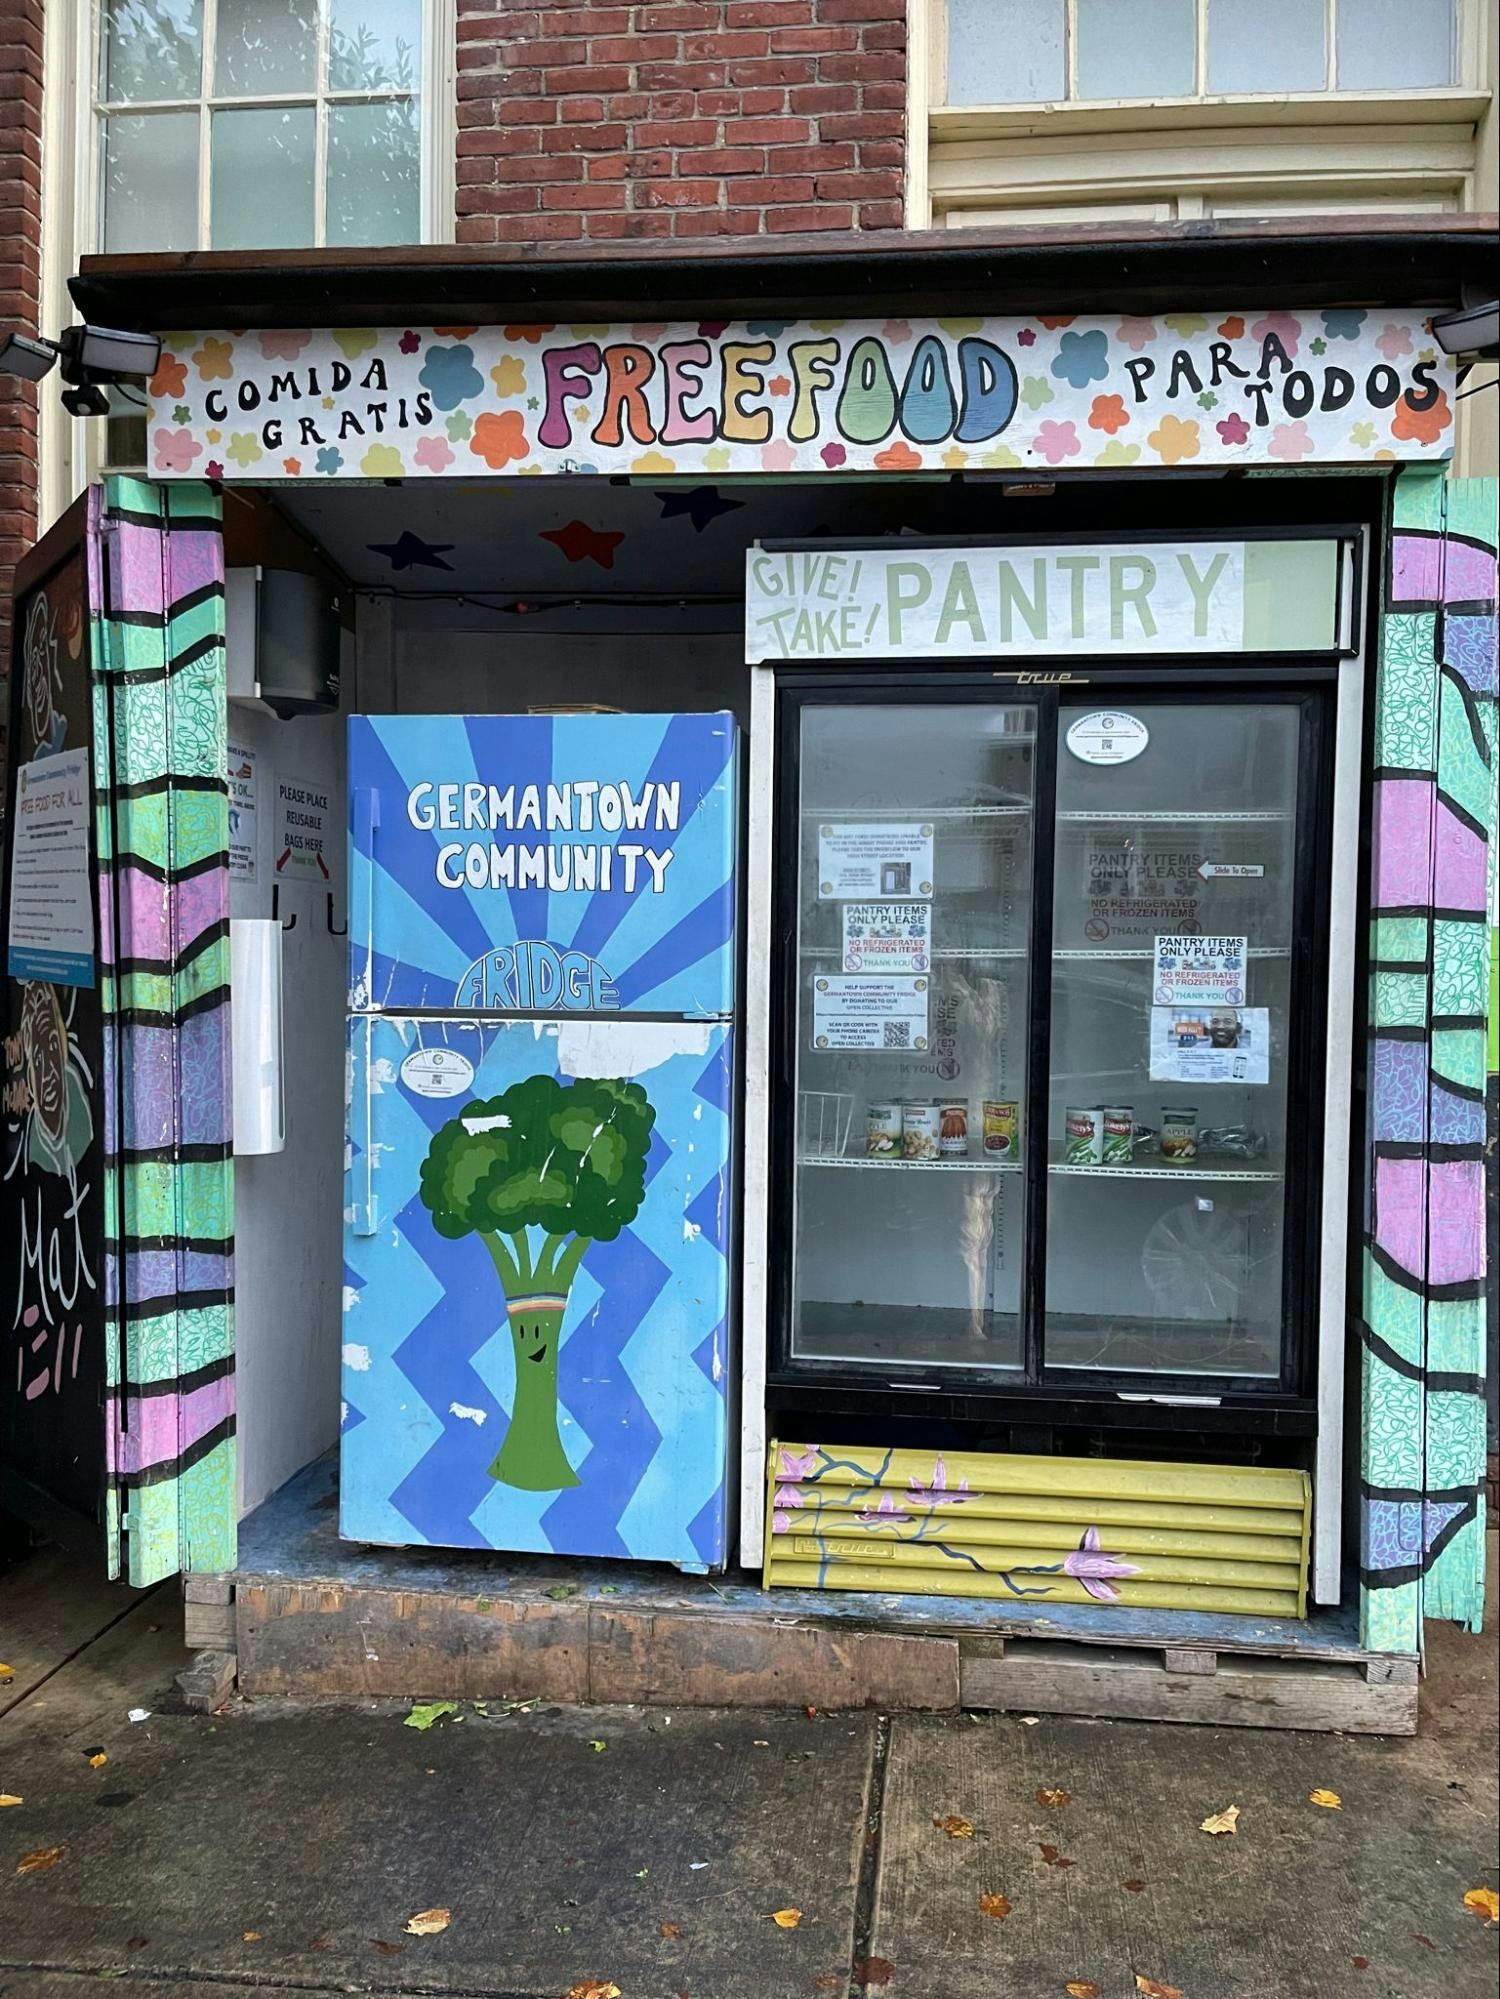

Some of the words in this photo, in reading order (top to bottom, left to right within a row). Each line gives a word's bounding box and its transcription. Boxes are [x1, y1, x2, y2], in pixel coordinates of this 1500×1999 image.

[1124, 332, 1292, 402] PARA
[205, 357, 388, 422] COMIDA
[538, 341, 776, 449] FREE
[787, 334, 1020, 446] FOOD
[1244, 361, 1439, 426] TODOS
[263, 392, 433, 449] GRATIS
[753, 553, 863, 602] GIVE!
[885, 552, 1230, 646] PANTRY
[756, 603, 881, 658] TAKE!
[279, 784, 305, 804] PLEASE
[306, 792, 328, 810] PLACE
[406, 780, 680, 832] GERMANTOWN
[286, 810, 322, 831] REUSABLE
[284, 833, 304, 850] BAGS
[304, 839, 323, 853] HERE
[1089, 853, 1150, 866] PANTRY
[1154, 853, 1201, 866] ITEMS
[435, 842, 675, 893] COMMUNITY
[1136, 866, 1197, 879] PLEASE
[1213, 866, 1231, 875] Slide
[1240, 866, 1258, 877] Open
[1091, 899, 1108, 908] NO
[846, 906, 890, 915] PANTRY
[893, 906, 928, 916] ITEMS
[1092, 908, 1109, 918] OR
[1112, 908, 1157, 918] FROZEN
[1160, 908, 1196, 918] ITEMS
[848, 915, 878, 925] ONLY
[880, 915, 925, 925] PLEASE
[849, 939, 861, 947] NO
[863, 939, 926, 947] REFRIGERATED
[1159, 937, 1206, 947] PANTRY
[1207, 937, 1244, 948] ITEMS
[850, 946, 863, 954] OR
[864, 946, 897, 954] FROZEN
[899, 946, 924, 954] ITEMS
[1160, 947, 1191, 957] ONLY
[1194, 947, 1241, 957] PLEASE
[863, 959, 891, 967] THANK
[893, 959, 911, 967] YOU
[455, 939, 622, 1010] FRIDGE
[1160, 971, 1173, 979] NO
[1174, 971, 1241, 979] REFRIGERATED
[1212, 979, 1239, 987] ITEMS
[1175, 991, 1205, 1000] THANK
[1206, 992, 1224, 1001] YOU
